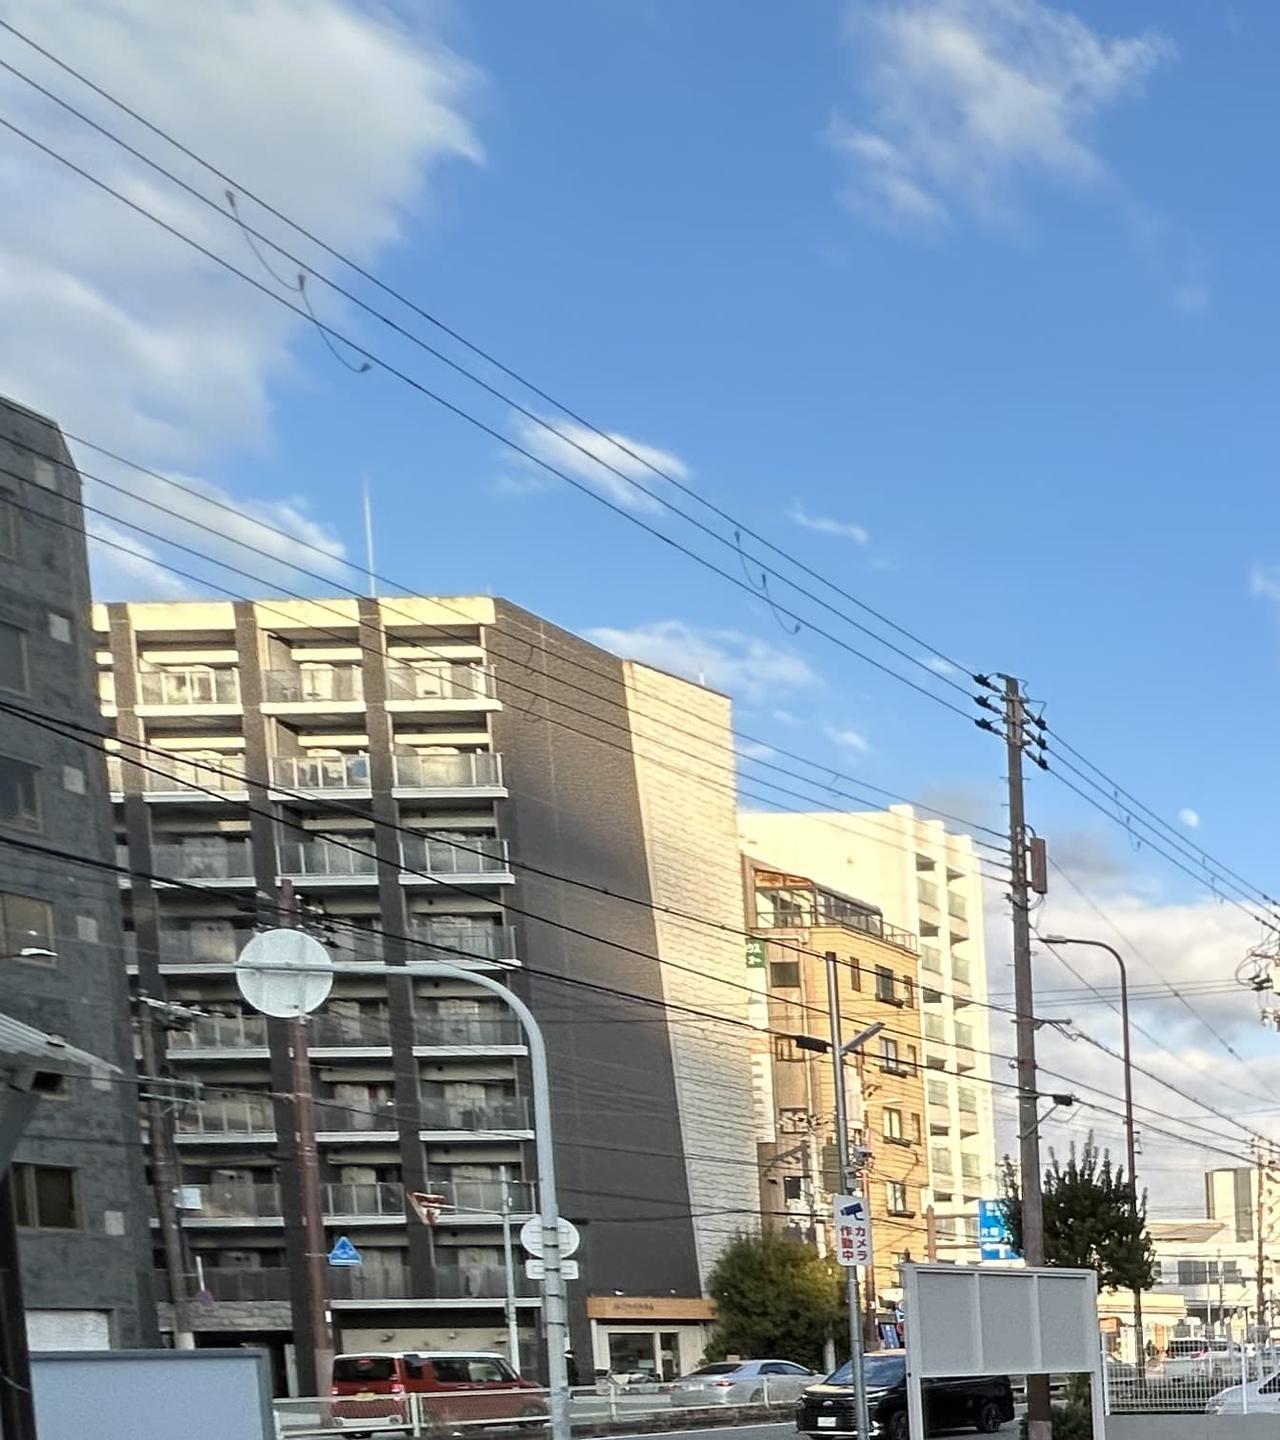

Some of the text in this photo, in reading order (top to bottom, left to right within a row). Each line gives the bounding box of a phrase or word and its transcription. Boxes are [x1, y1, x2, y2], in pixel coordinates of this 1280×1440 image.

[840, 1225, 854, 1262] 作動中
[855, 1226, 868, 1261] カメラ
